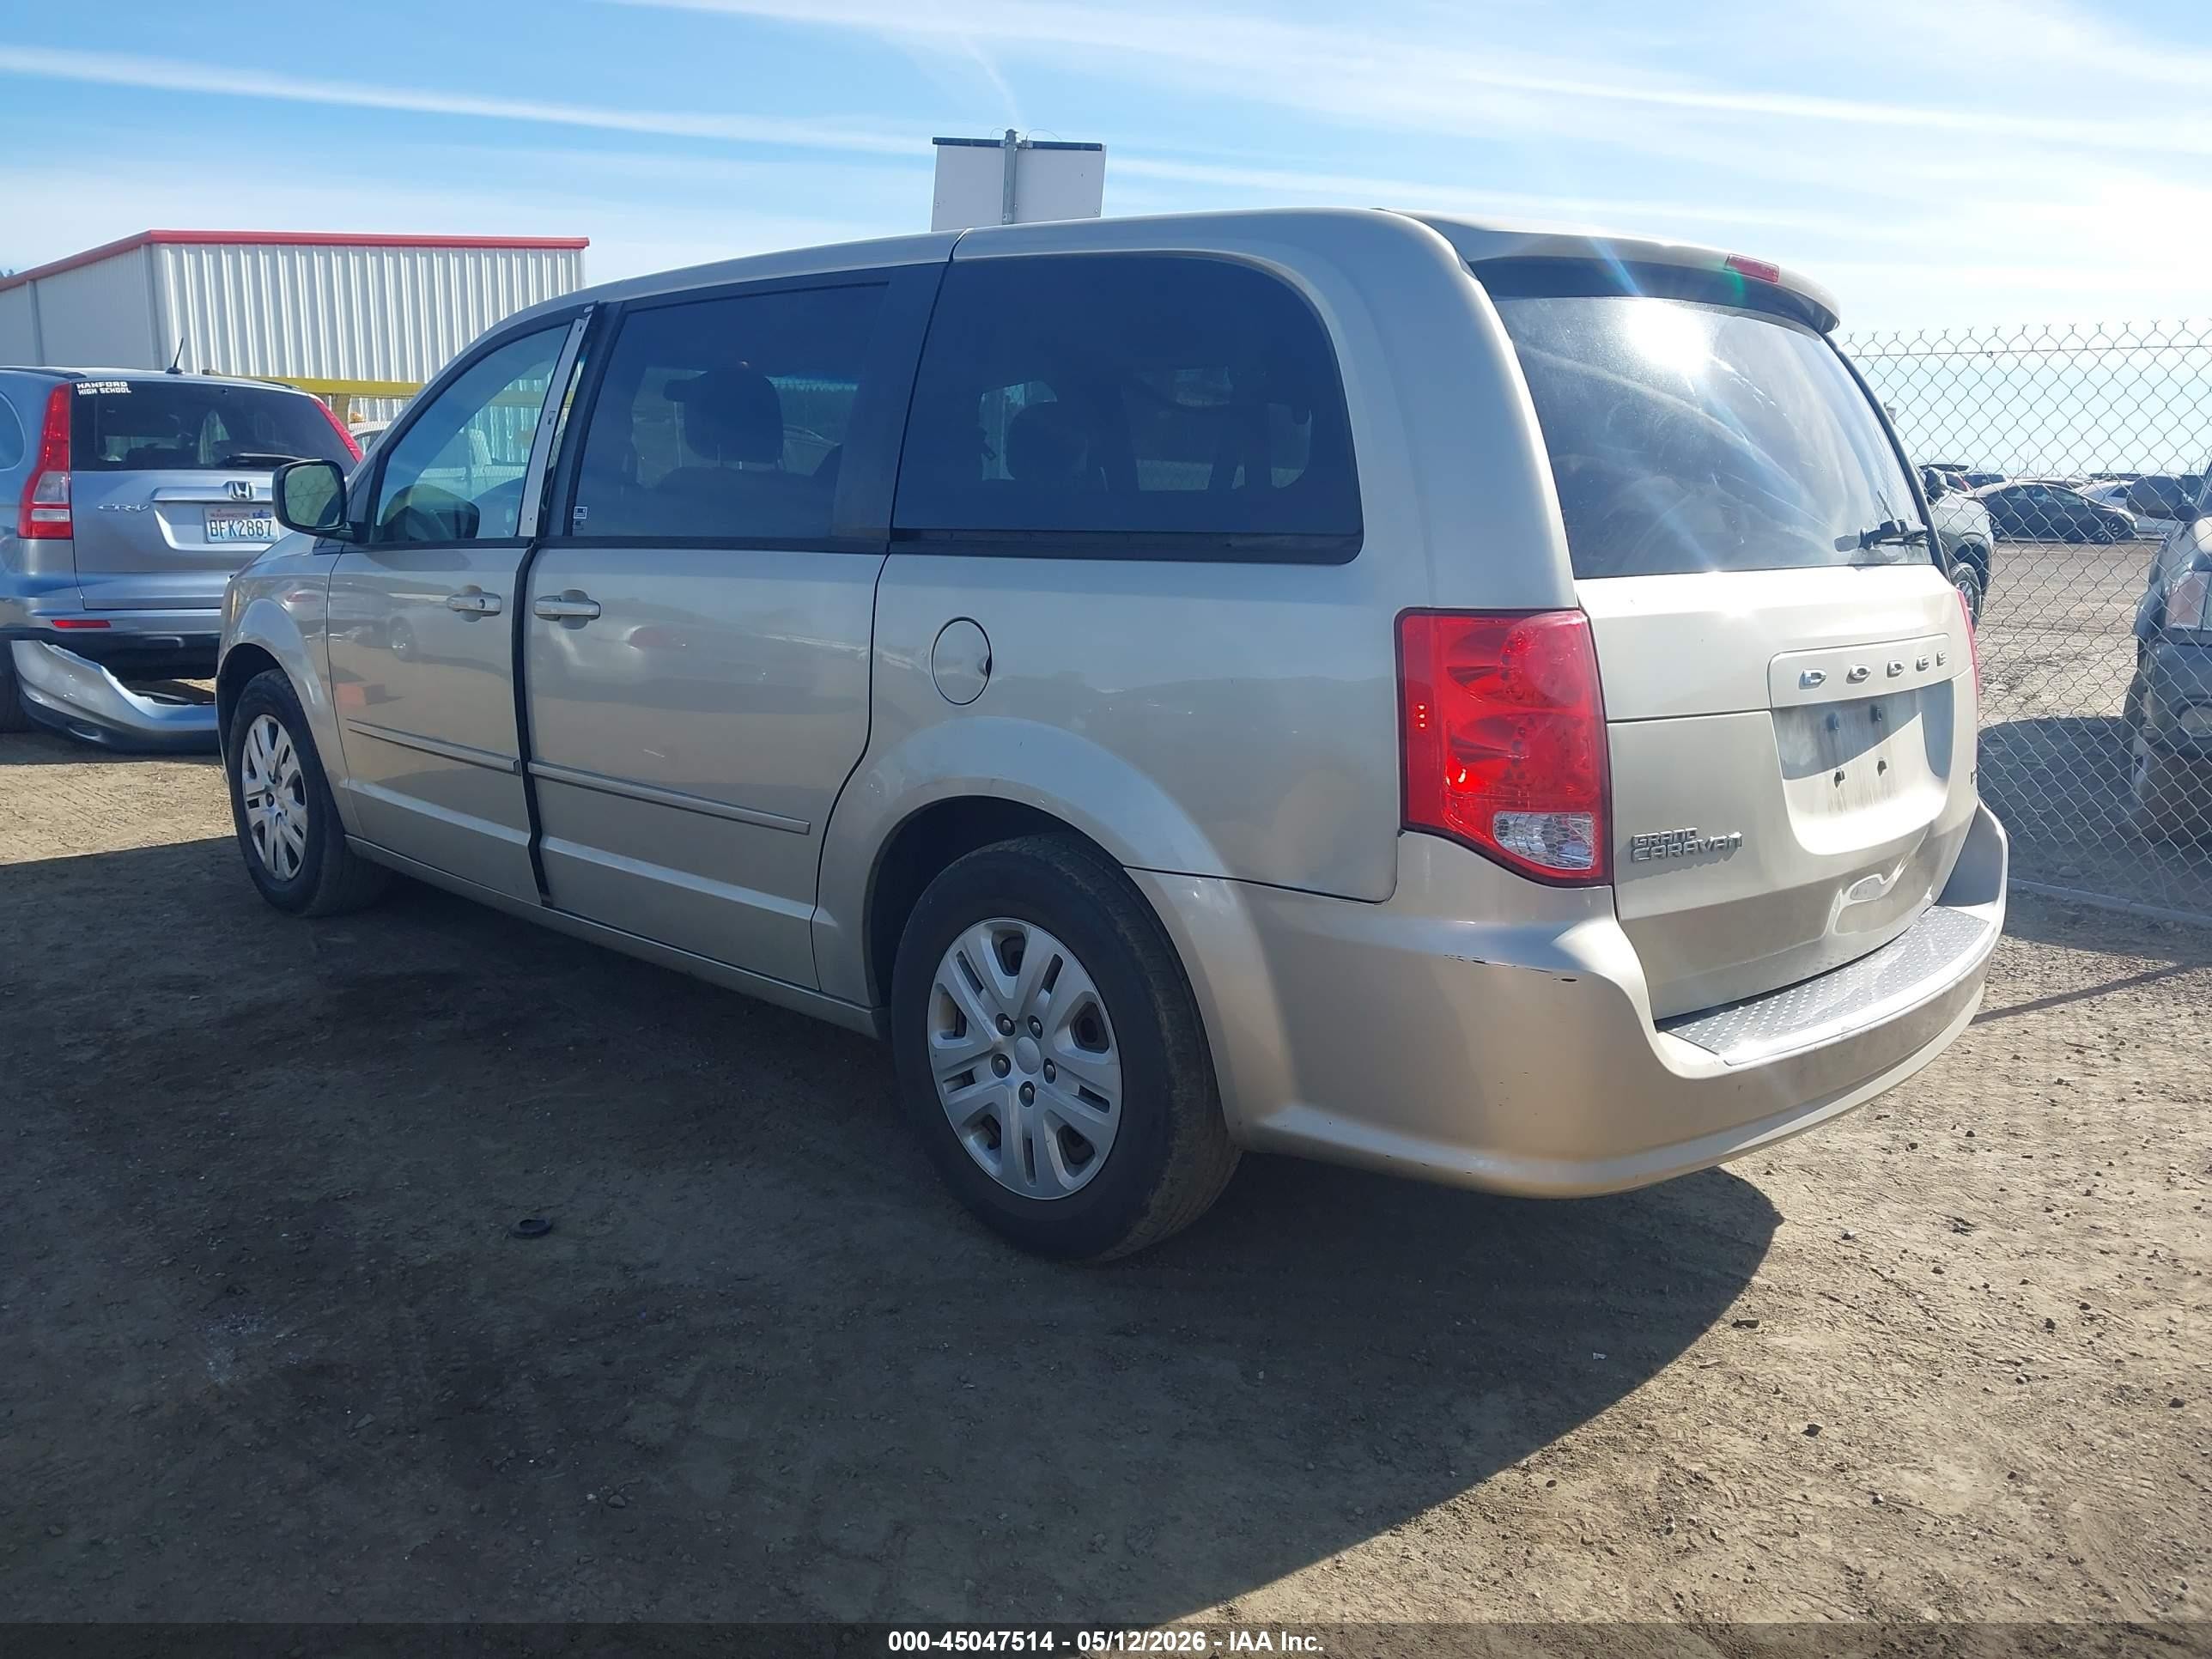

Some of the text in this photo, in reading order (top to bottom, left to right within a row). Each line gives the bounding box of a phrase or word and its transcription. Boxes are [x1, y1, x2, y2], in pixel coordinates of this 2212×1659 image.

[210, 520, 273, 538] BFK2887
[1800, 651, 1947, 689] DODGE
[1631, 828, 1698, 848] GRAND
[1631, 831, 1744, 862] CARAVAN
